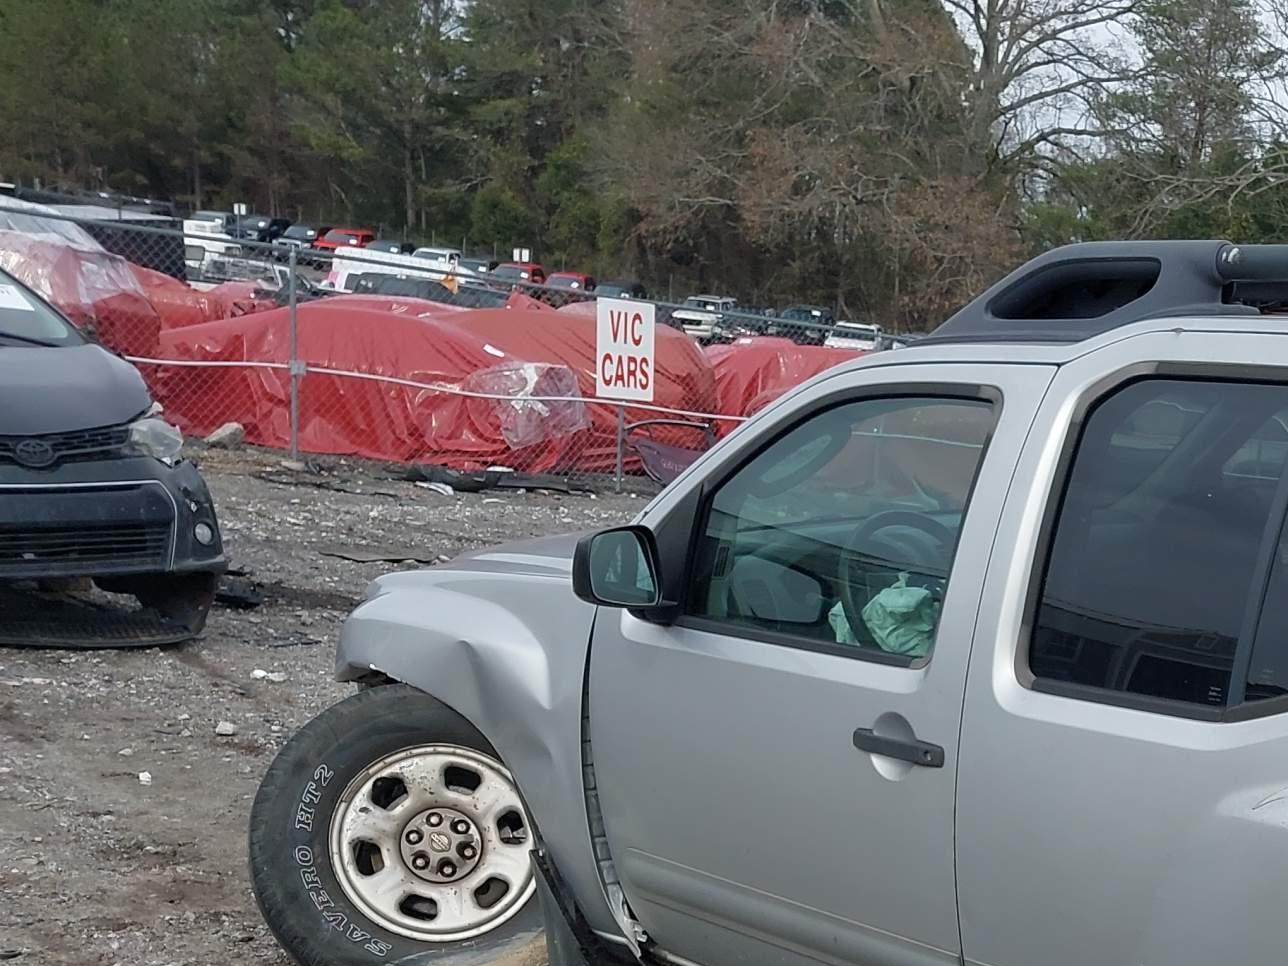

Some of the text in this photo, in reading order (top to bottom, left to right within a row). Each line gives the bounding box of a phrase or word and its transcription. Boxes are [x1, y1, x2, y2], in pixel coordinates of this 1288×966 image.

[610, 309, 642, 346] VIC
[601, 352, 649, 390] CARS
[295, 764, 392, 956] SAVERO HT2
